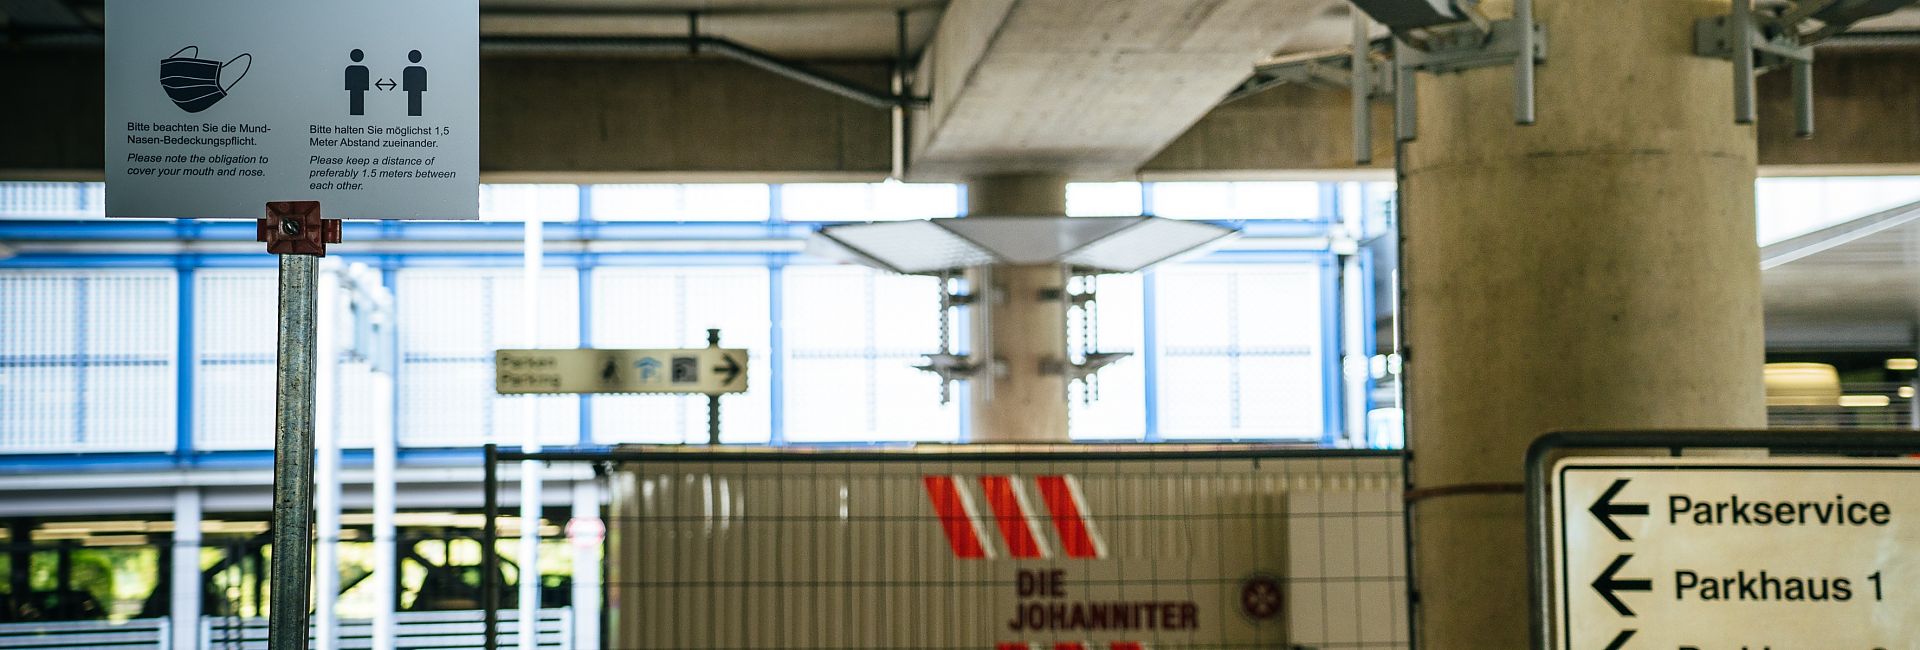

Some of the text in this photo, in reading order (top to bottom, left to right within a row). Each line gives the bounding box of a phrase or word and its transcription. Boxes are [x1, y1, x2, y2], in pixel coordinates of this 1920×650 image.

[127, 122, 271, 133] Bitte beachten Sie die Mund-
[309, 124, 450, 137] Bitte halten Sie möglichst 1,5
[127, 135, 257, 147] Nasen-Bedeckungspflicht.
[309, 137, 439, 148] Meter Abstand zueinander.
[127, 153, 269, 165] Please note the obligation to
[309, 155, 344, 165] Please
[346, 156, 370, 167] keep
[381, 156, 422, 166] distance
[424, 156, 436, 166] of
[127, 167, 265, 178] cover your mouth and nose.
[309, 168, 457, 180] preferably 1.5 meters between
[309, 181, 364, 191] each other.
[1668, 493, 1892, 526] Parkservice
[1016, 569, 1067, 599] DIE
[1674, 569, 1884, 603] Parkhaus 1
[1009, 602, 1200, 632] JOHANNITER
